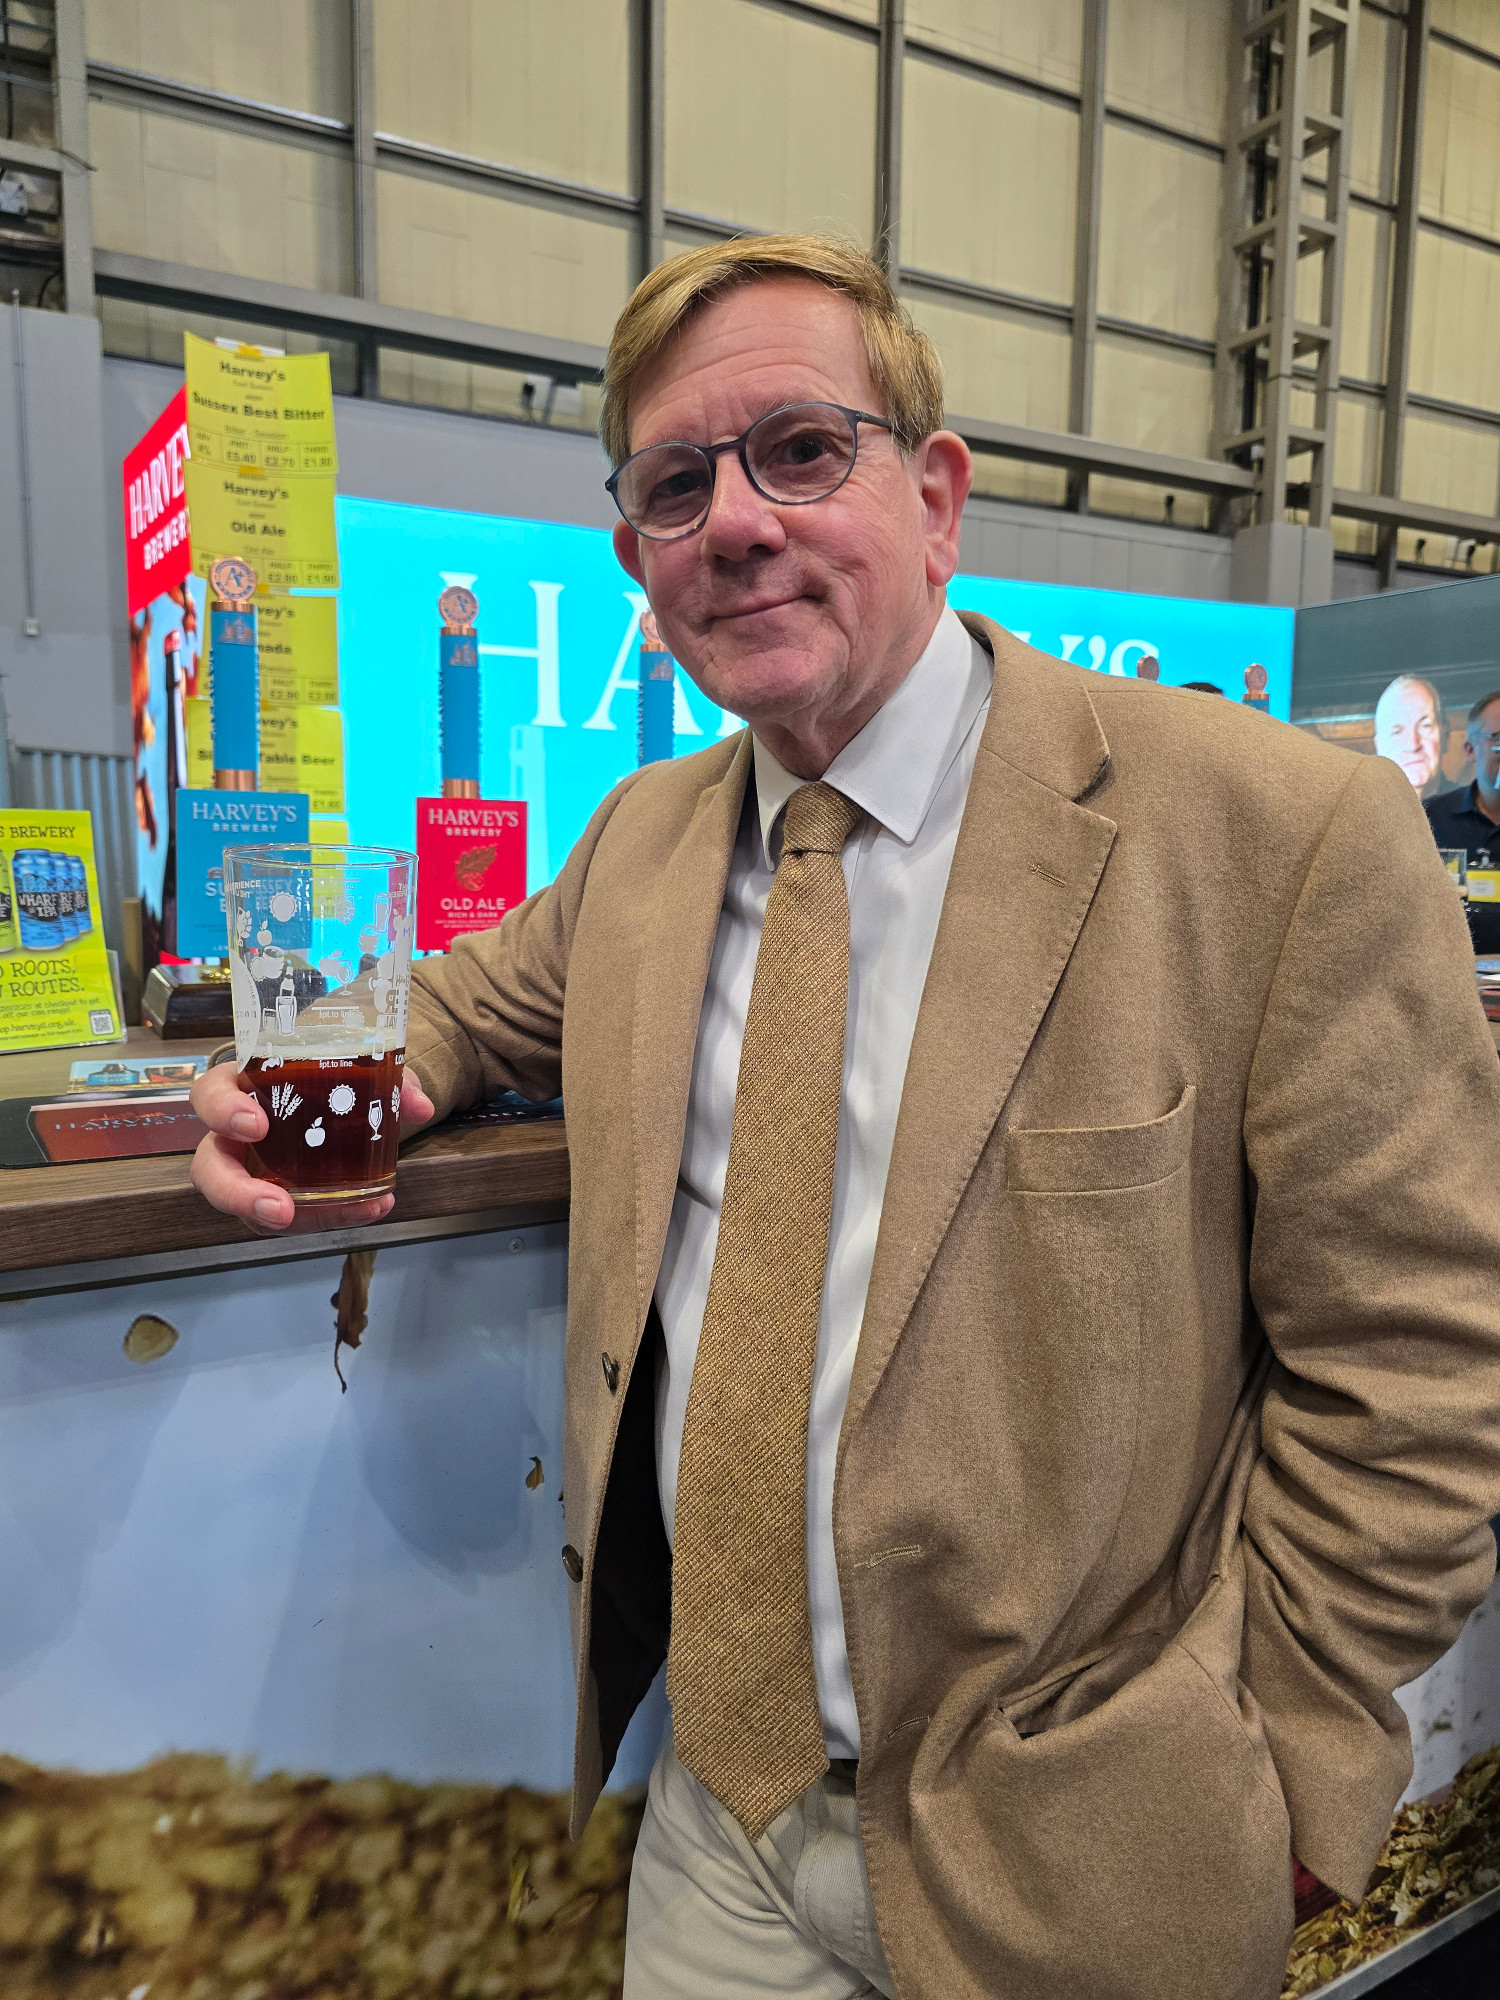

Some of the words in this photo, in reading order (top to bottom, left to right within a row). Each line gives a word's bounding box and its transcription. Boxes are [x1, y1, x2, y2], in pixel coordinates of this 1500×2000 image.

[219, 361, 287, 383] Harvey's
[192, 391, 238, 415] Sussex
[243, 404, 279, 420] Best
[284, 408, 325, 421] Bitter
[128, 423, 191, 540] HARVE
[223, 480, 290, 501] Harvey's
[230, 520, 257, 536] Old
[261, 522, 287, 537] Ale
[257, 605, 295, 620] vey's
[260, 717, 299, 730] vey's
[301, 753, 337, 765] Beer
[191, 801, 298, 823] HARVEY'S
[427, 807, 520, 828] HARVEY'S
[9, 825, 77, 839] BREWERY
[211, 823, 278, 833] BREWERY
[445, 827, 502, 838] BREWERY
[440, 897, 474, 911] OLD
[475, 897, 506, 911] ALE
[9, 977, 85, 998] ROUTES.
[0, 1018, 75, 1034] op.harveys.org.uk
[340, 1059, 353, 1068] line
